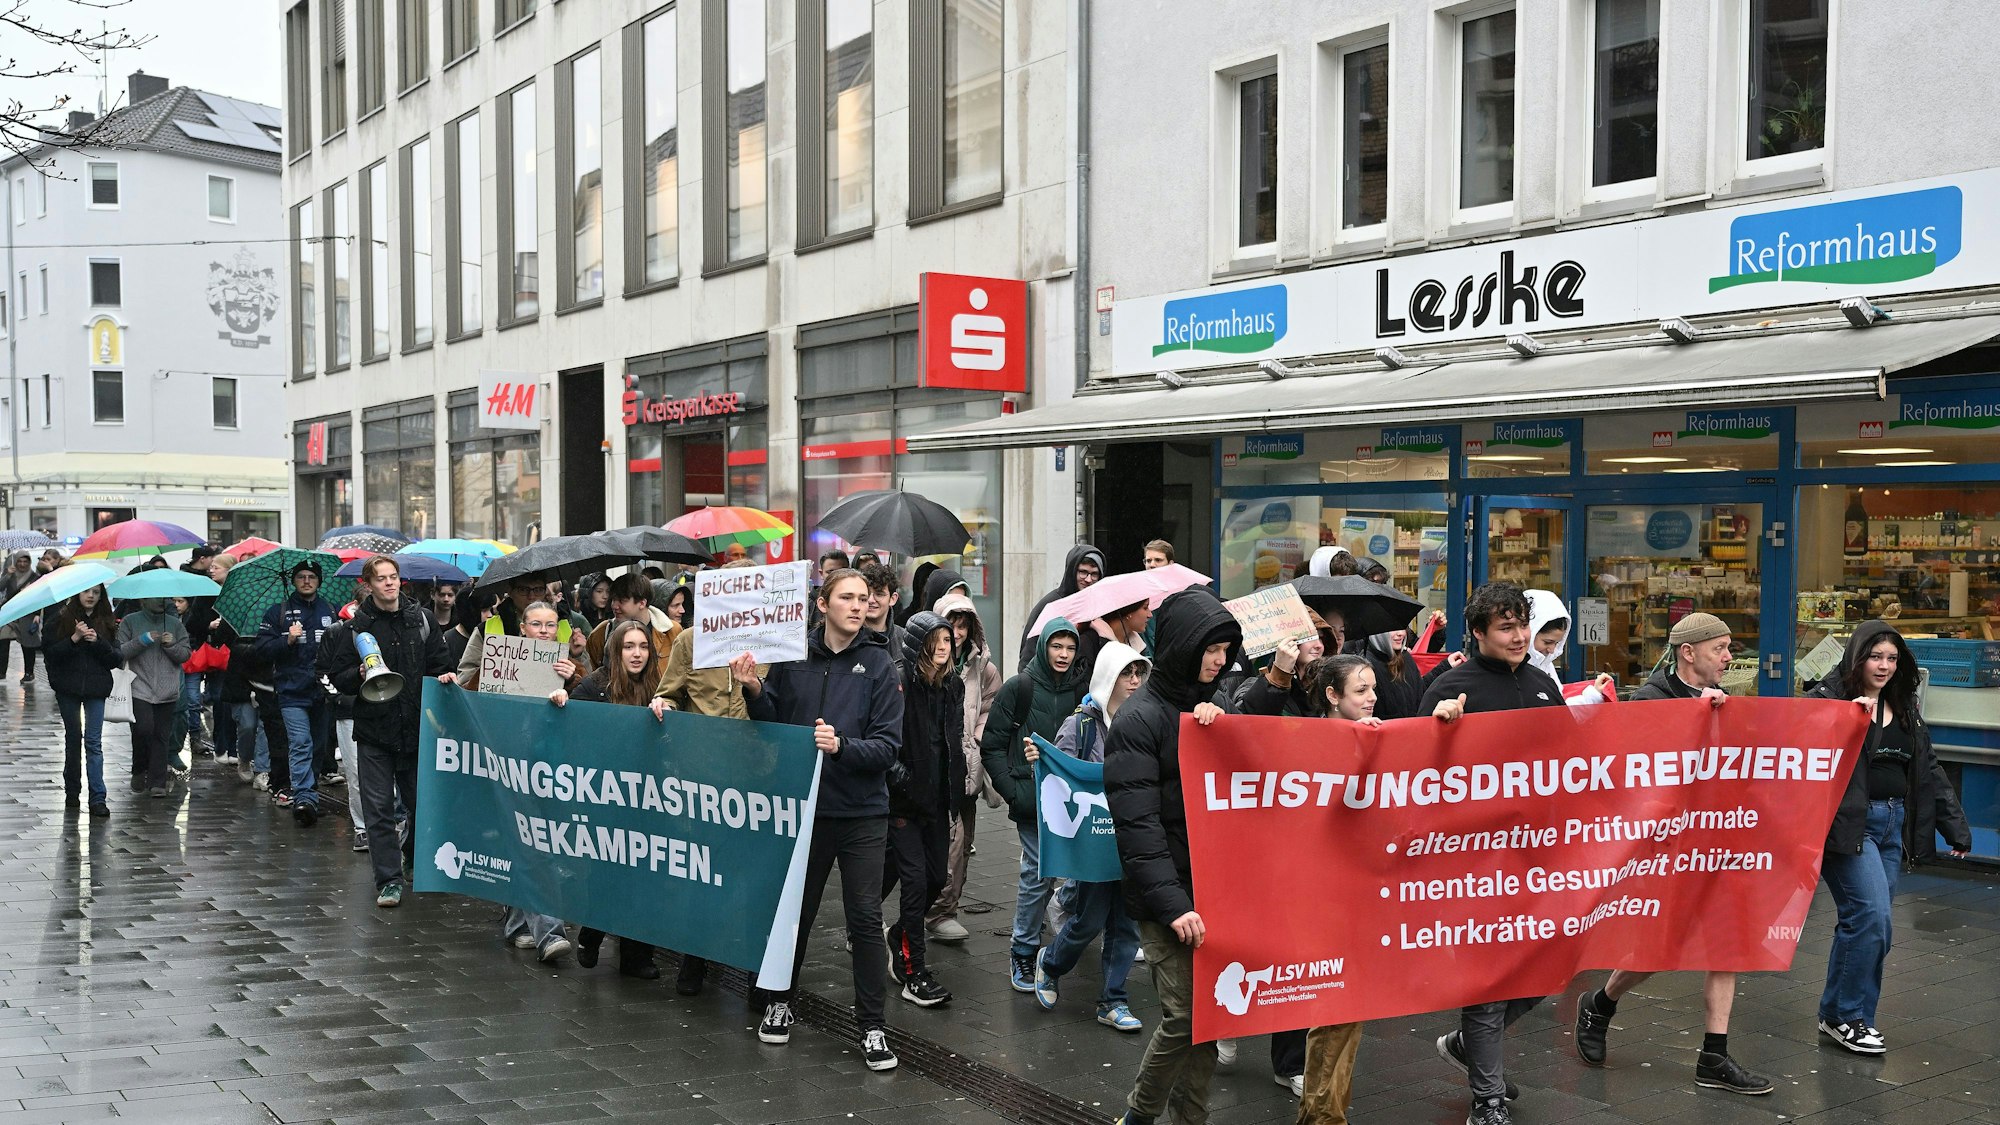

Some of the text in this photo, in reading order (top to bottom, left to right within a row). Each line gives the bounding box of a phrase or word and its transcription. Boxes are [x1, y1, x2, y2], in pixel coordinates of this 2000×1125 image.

[1736, 223, 1937, 282] Reformhaus
[1376, 250, 1586, 339] Lesske
[1166, 307, 1276, 351] Reformhaus
[486, 382, 536, 419] H&M
[642, 389, 739, 425] Kreissparkasse
[1903, 400, 2000, 427] Reformhaus
[1496, 423, 1564, 445] Reformhaus
[1688, 413, 1771, 436] Reformhaus
[1246, 439, 1299, 458] Reformhaus
[1382, 429, 1444, 450] Reformhaus
[702, 573, 766, 597] BÜCHER
[762, 588, 797, 605] STATT
[1247, 613, 1260, 623] der
[486, 636, 562, 663] Schule brennt
[483, 658, 519, 681] Politik
[1204, 756, 1619, 811] LEISTUNGSDRUCK
[514, 811, 723, 887] BEKÄMPFEN.
[1406, 823, 1558, 857] alternative
[473, 852, 512, 872] LSV NRW
[1400, 869, 1520, 902] mentale
[1671, 847, 1773, 876] chützen
[1400, 914, 1556, 950] Lehrkräfte
[1276, 957, 1344, 982] LSV NRW
[1257, 992, 1317, 1006] Nordrhein-Westfalen
